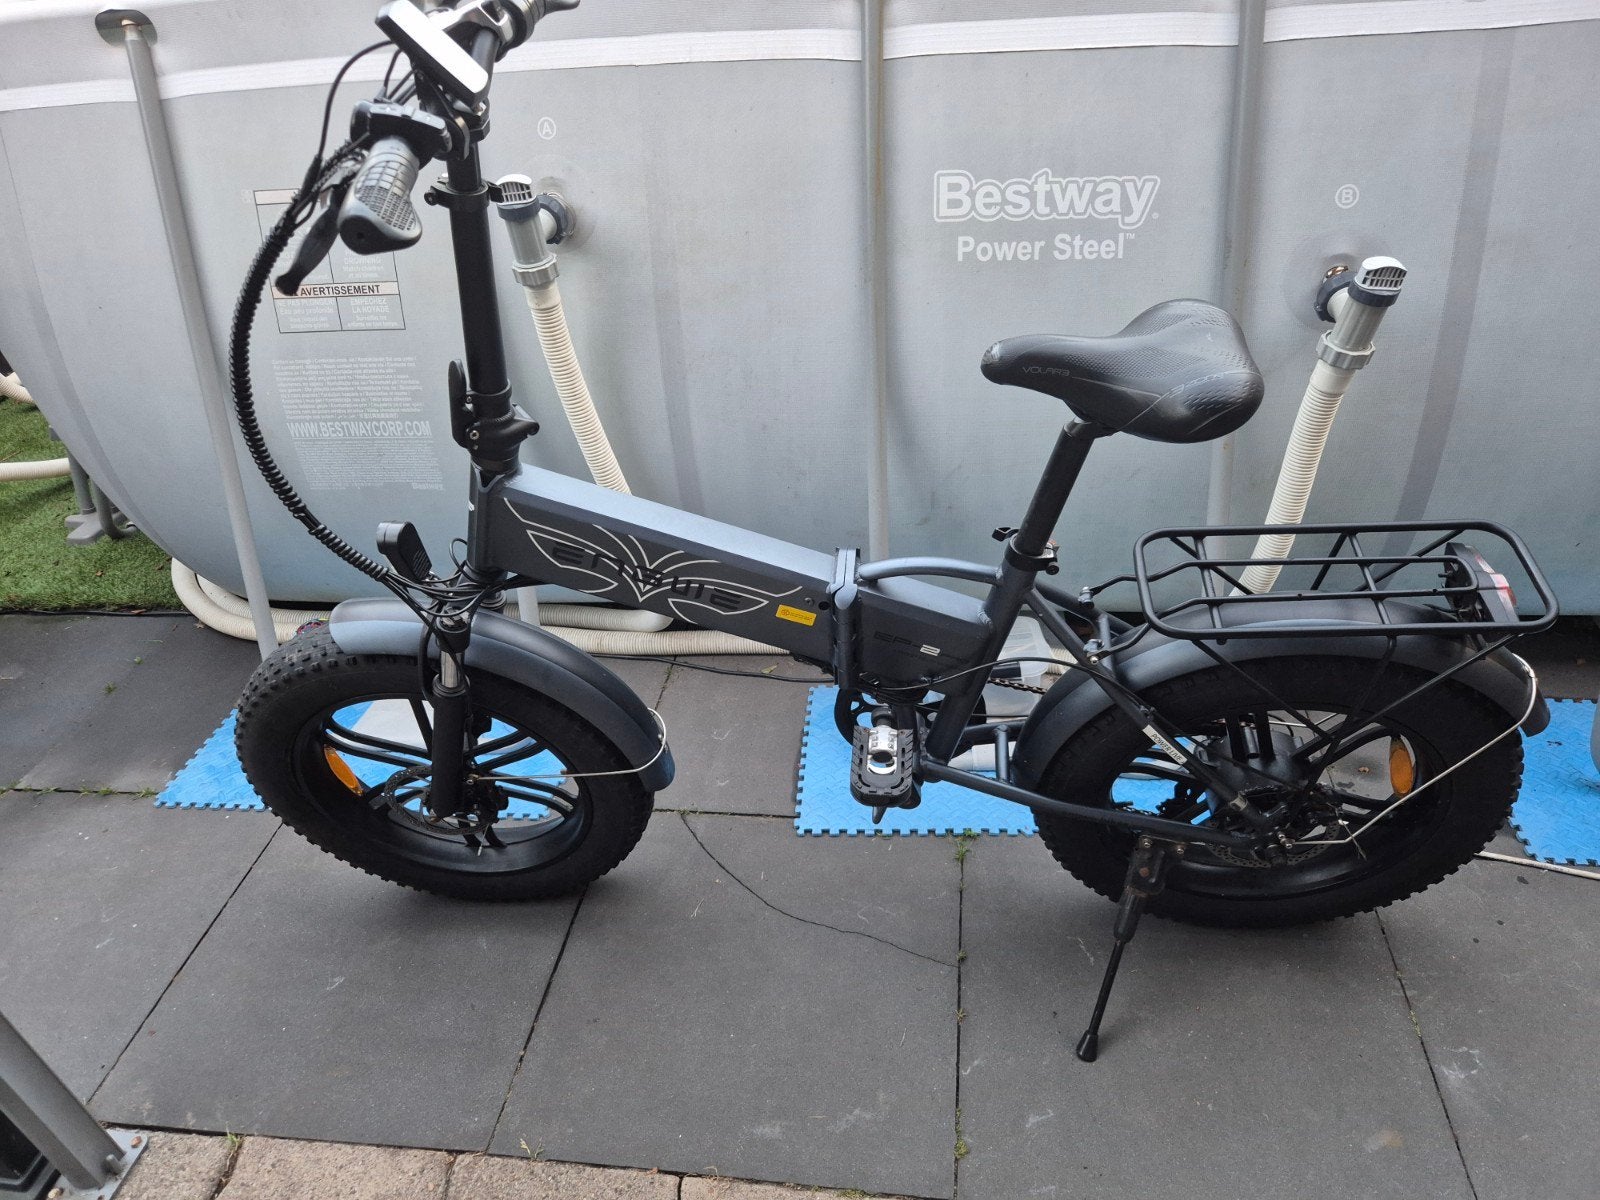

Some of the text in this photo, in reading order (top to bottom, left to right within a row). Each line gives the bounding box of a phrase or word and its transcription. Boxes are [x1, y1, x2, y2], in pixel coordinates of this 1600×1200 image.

[933, 168, 1160, 229] Bestway
[957, 235, 1046, 262] Power
[300, 284, 381, 297] AVERTISSEMENT
[286, 420, 433, 438] WWW.BESTWAYCORP.COM
